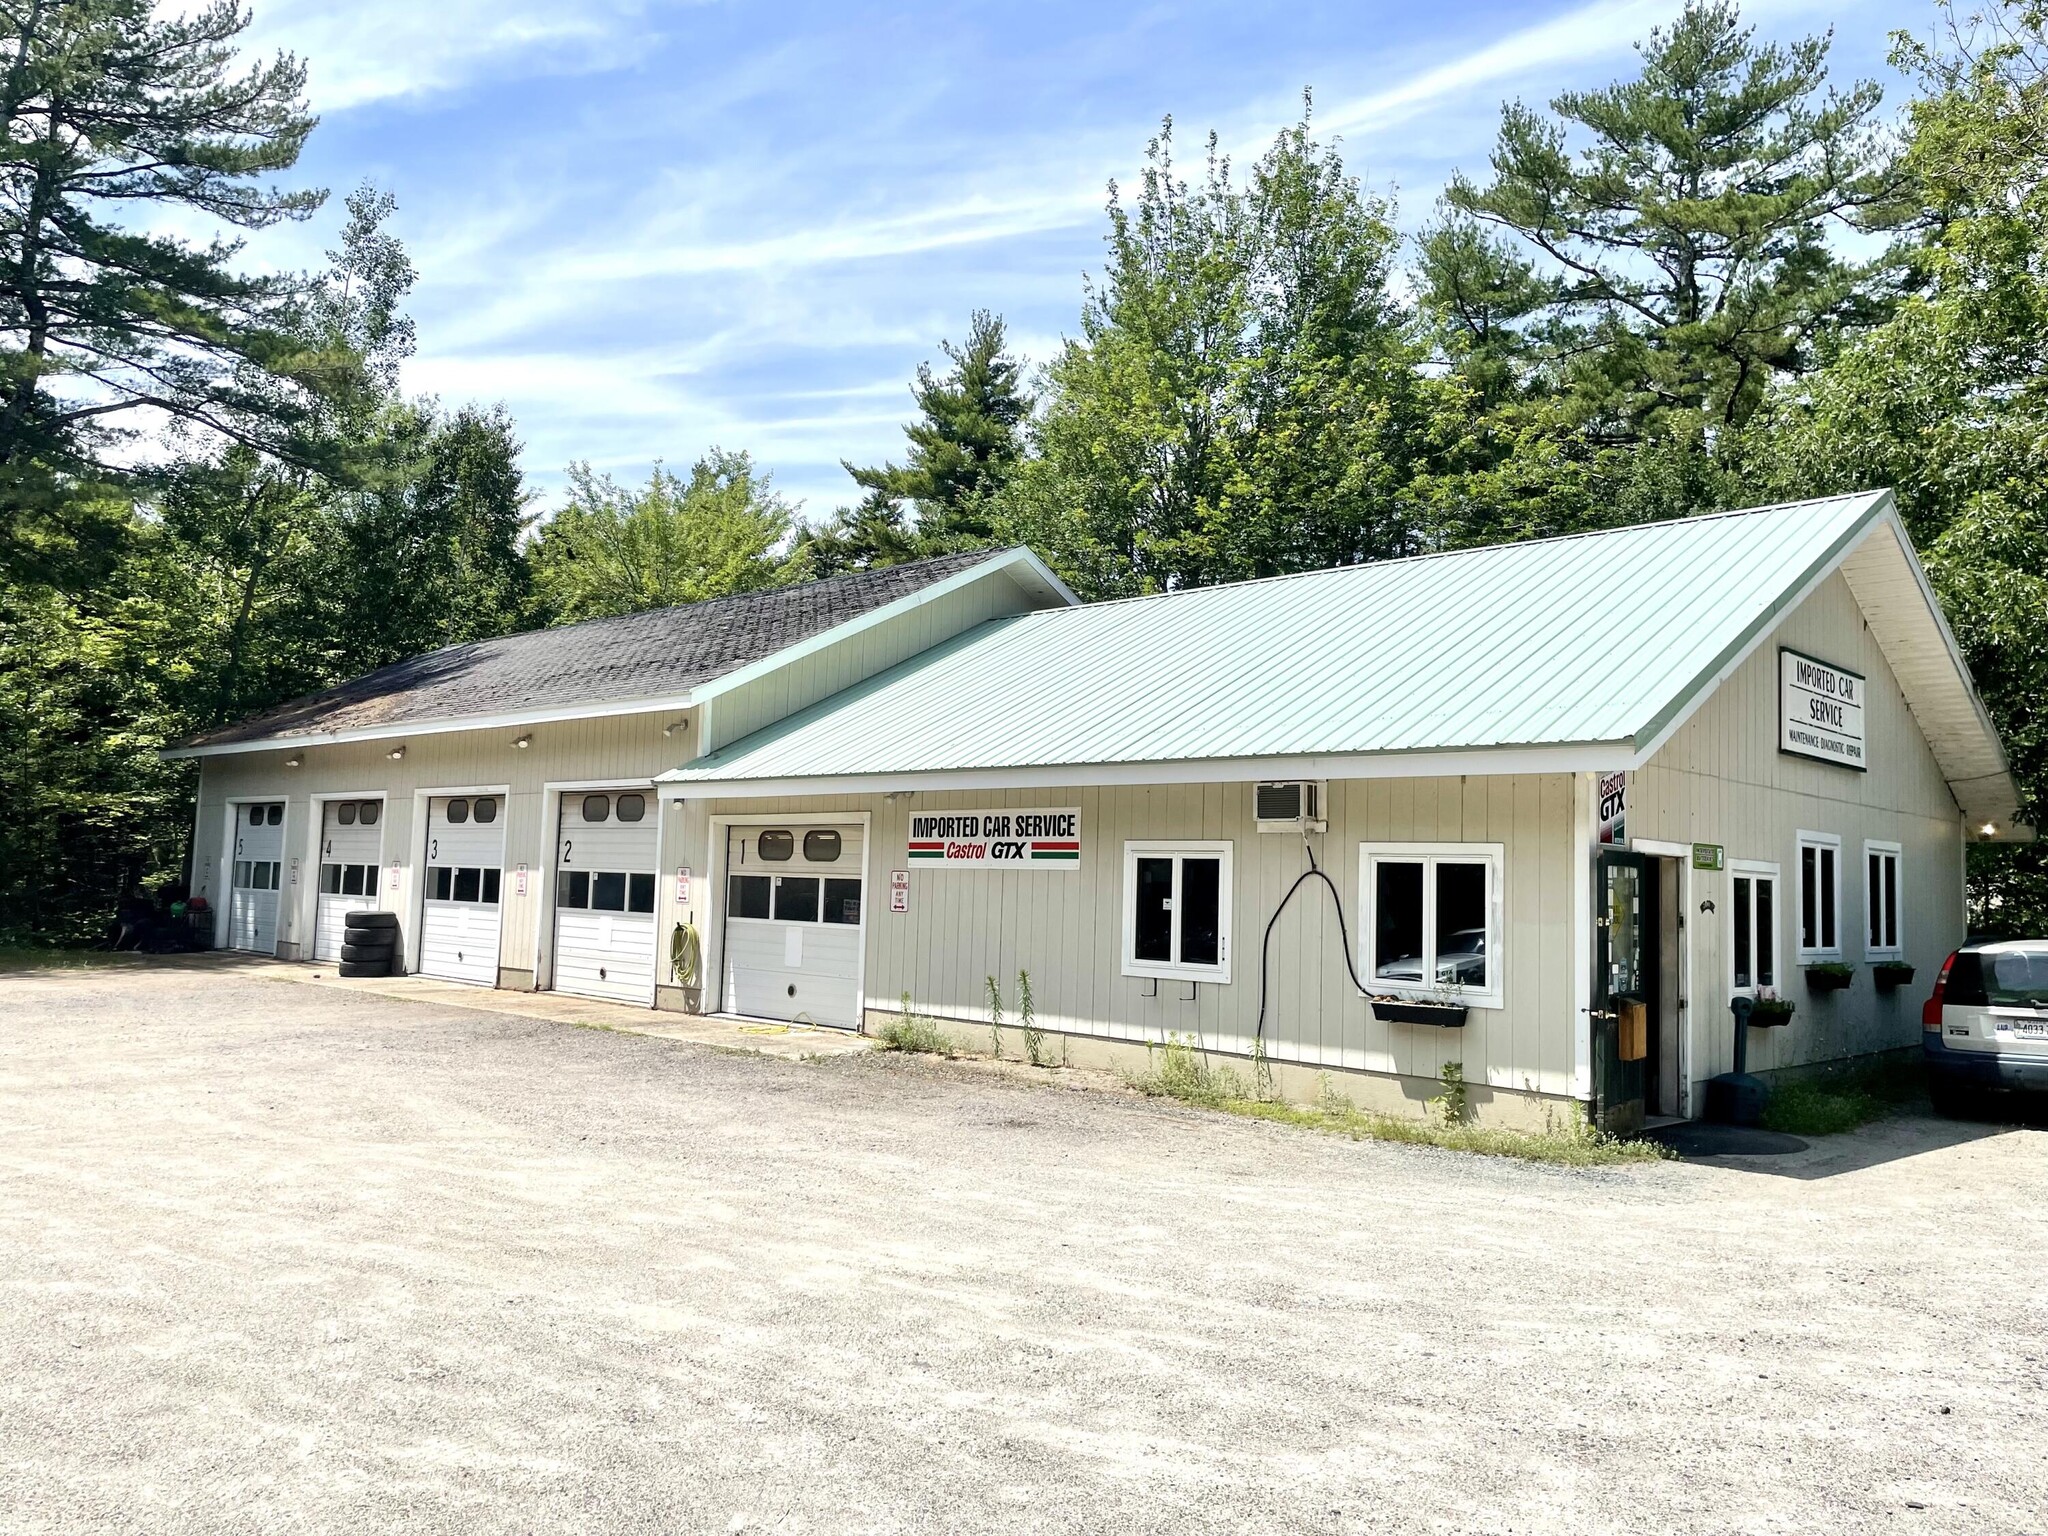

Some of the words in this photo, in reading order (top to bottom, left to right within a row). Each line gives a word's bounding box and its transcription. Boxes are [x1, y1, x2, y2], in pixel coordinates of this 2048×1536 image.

[1796, 660, 1836, 694] IMPORTED
[1838, 676, 1854, 701] CAR
[1810, 698, 1843, 728] SERVICE
[1788, 729, 1819, 748] MAINTENANCE
[1820, 737, 1845, 754] DIAGNOSTIC
[1846, 743, 1862, 759] REPAIR
[1600, 770, 1625, 799] Castrol
[1600, 787, 1625, 822] GTX
[913, 815, 980, 839] IMPORTED
[983, 816, 1011, 838] CAR
[1015, 814, 1077, 838] SERVICE
[238, 838, 244, 855] 5
[326, 839, 332, 857] 4
[431, 839, 438, 860] 3
[563, 840, 572, 863] 2
[741, 839, 746, 864] 1
[946, 841, 987, 860] Castrol
[991, 841, 1027, 860] GTX
[896, 873, 904, 881] NO
[2022, 1024, 2044, 1035] 4033
